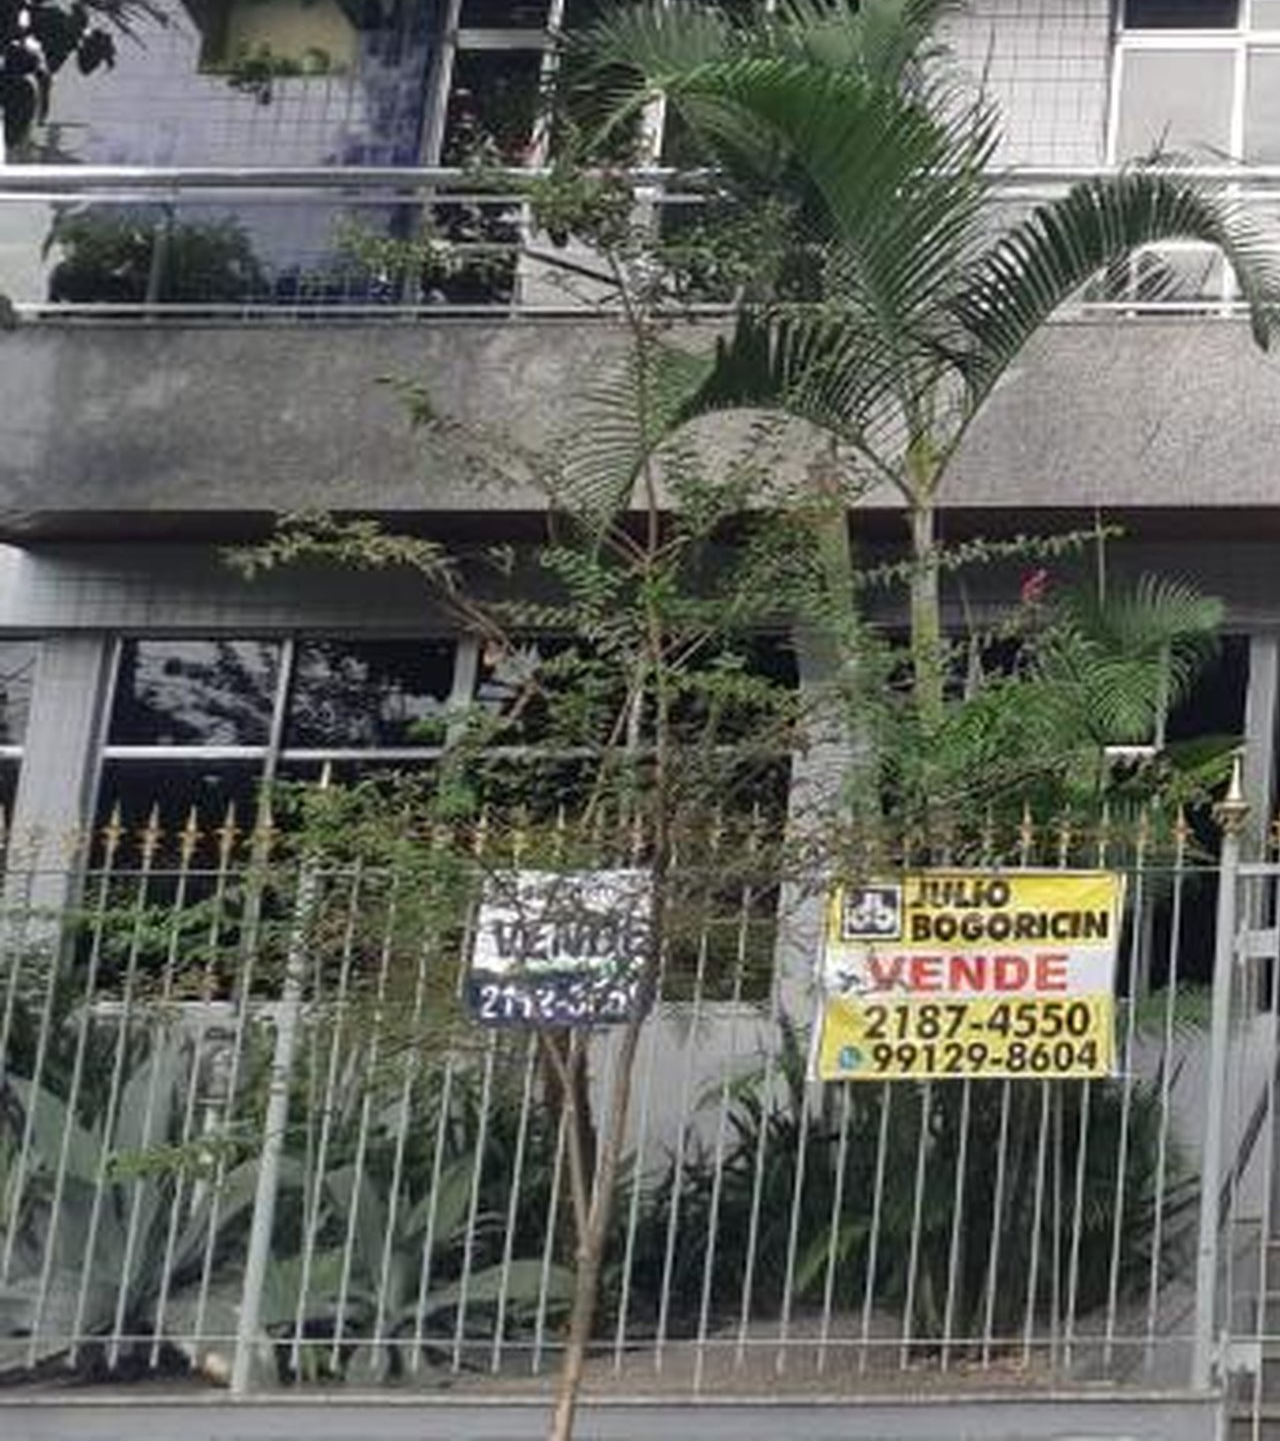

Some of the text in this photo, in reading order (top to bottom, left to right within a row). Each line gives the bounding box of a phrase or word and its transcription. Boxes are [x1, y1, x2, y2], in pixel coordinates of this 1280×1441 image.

[911, 880, 1011, 908] JULIO
[911, 911, 1110, 942] BOGORICIN
[867, 954, 1069, 991] VENDE
[863, 1003, 1091, 1039] 2187-4550
[872, 1041, 1098, 1073] 99129-8604
